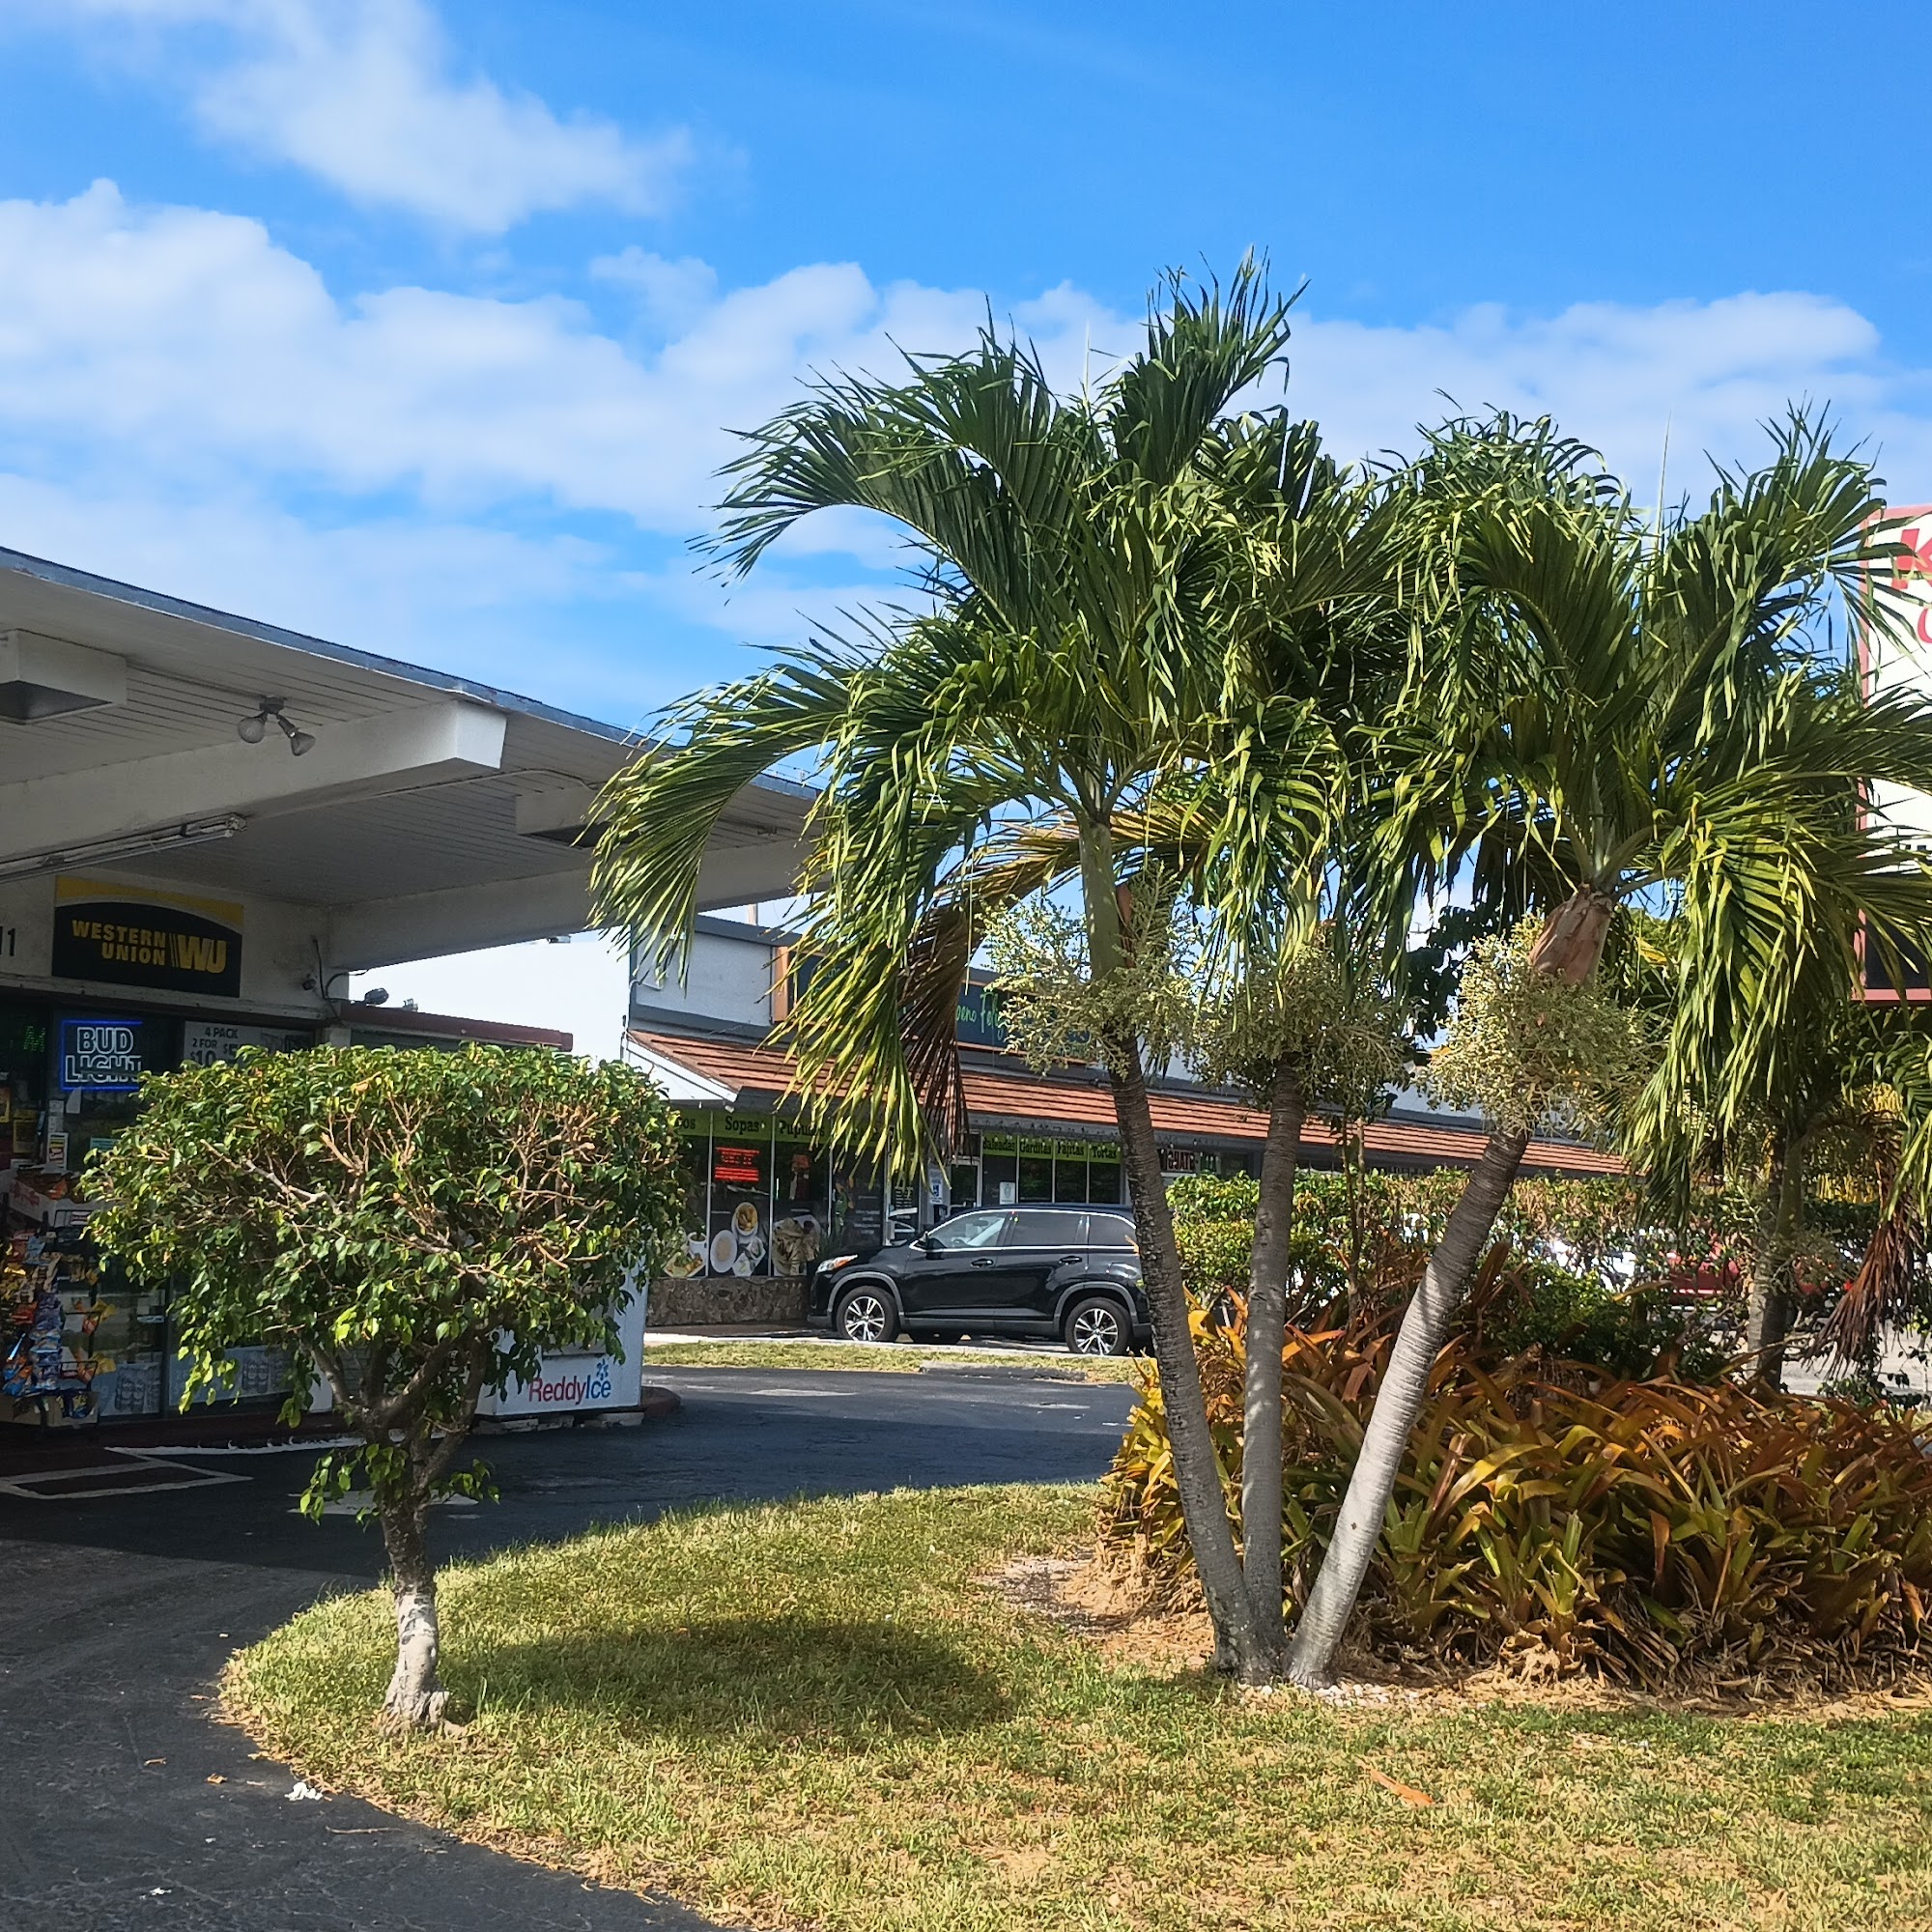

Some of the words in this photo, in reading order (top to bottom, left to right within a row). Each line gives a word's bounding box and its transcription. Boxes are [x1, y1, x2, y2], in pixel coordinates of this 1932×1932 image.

[72, 920, 166, 949] WESTERN
[101, 941, 165, 966] UNION
[177, 934, 227, 974] WU
[76, 1027, 134, 1055] BUD
[205, 1027, 211, 1037] 4
[213, 1027, 239, 1038] PACK
[192, 1037, 198, 1047] 2
[199, 1038, 217, 1049] FOR
[65, 1055, 143, 1084] LIGHT
[724, 1116, 759, 1135] Sopas
[779, 1120, 825, 1138] Pupus
[1019, 1140, 1052, 1154] Gorditas
[1057, 1141, 1085, 1157] Fajitas
[1092, 1145, 1117, 1159] Tortas
